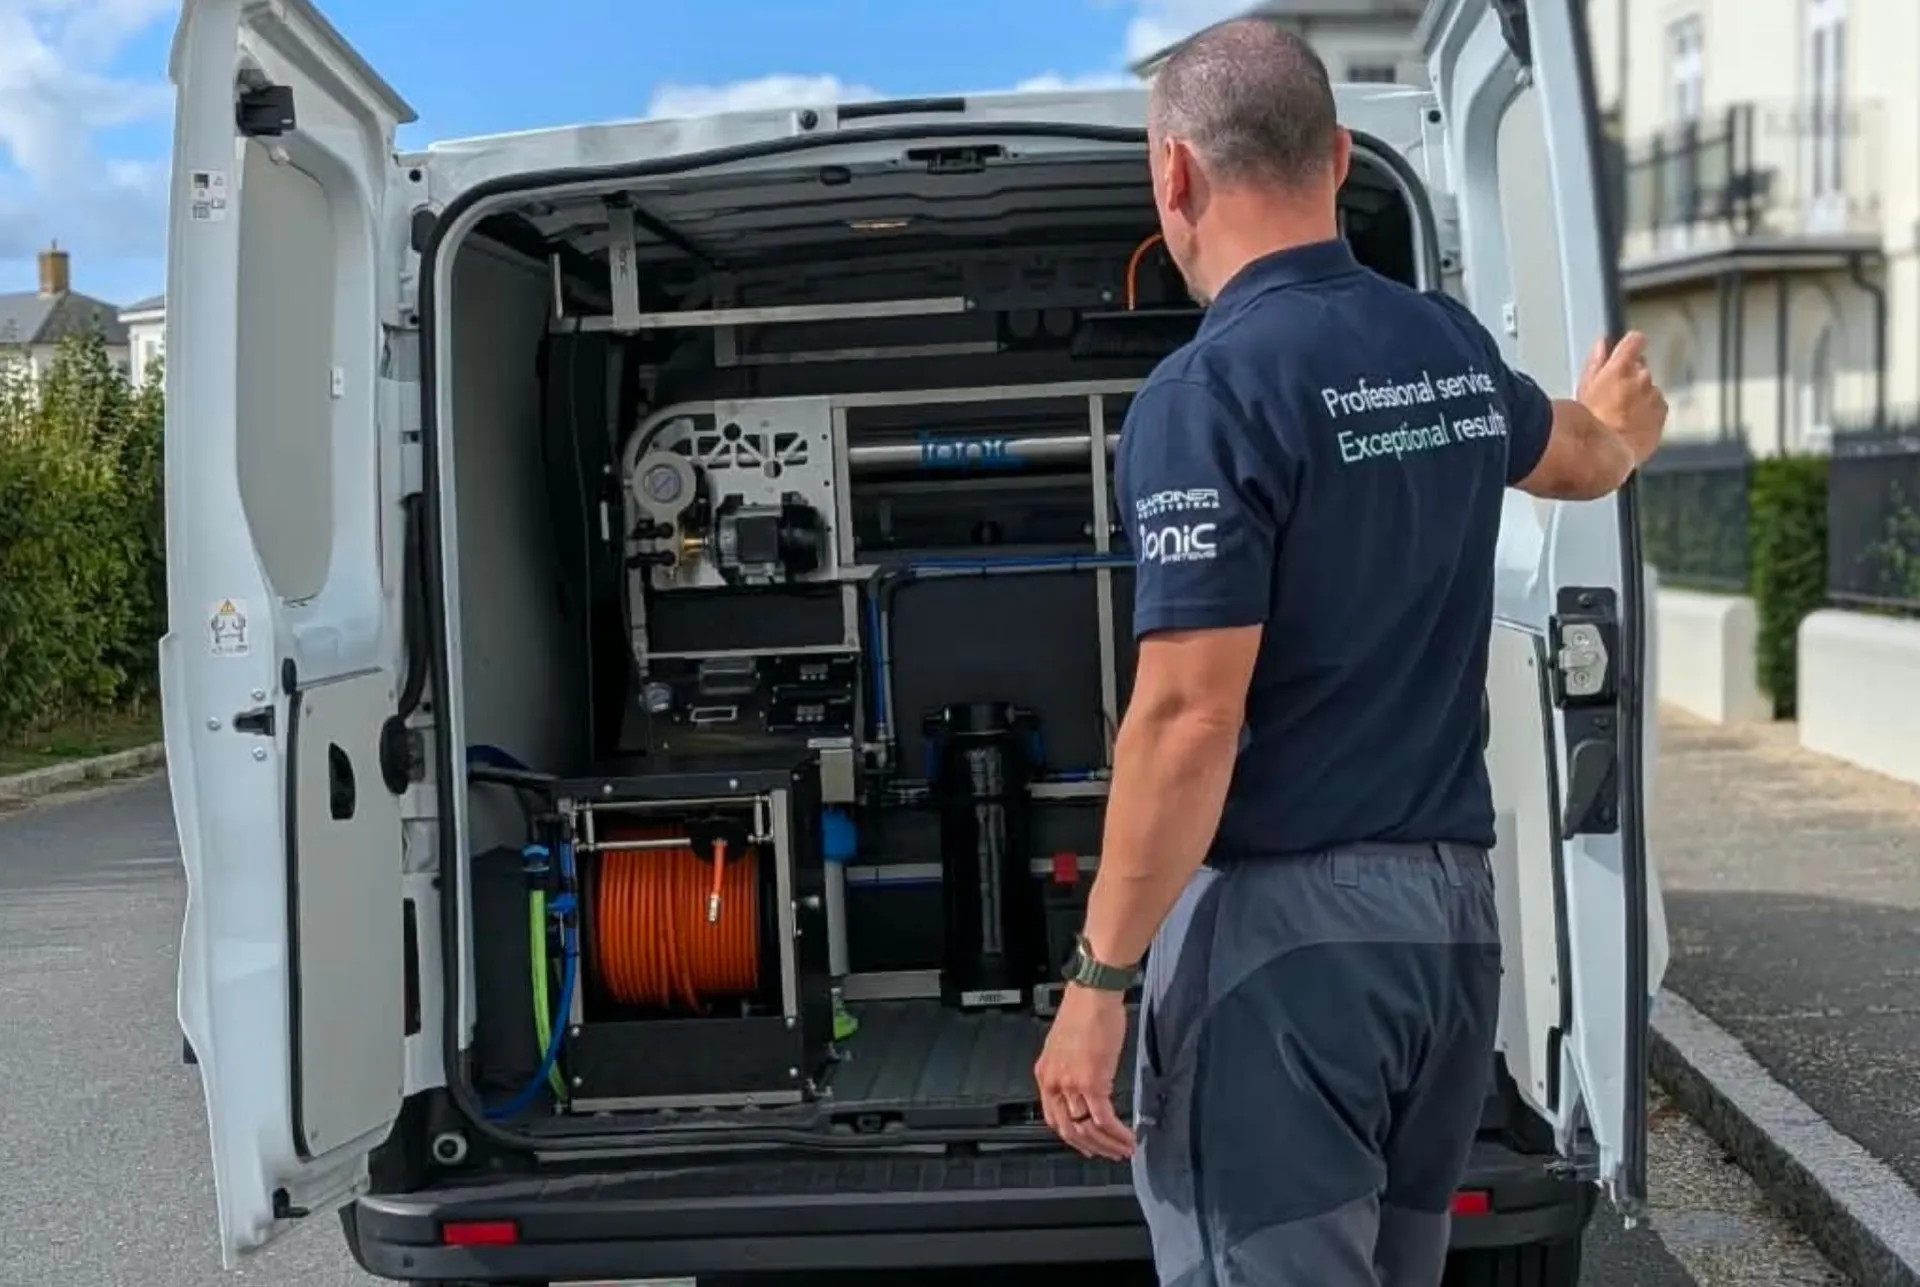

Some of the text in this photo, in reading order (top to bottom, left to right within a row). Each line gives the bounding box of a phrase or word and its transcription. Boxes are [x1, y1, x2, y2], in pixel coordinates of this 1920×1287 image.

[1321, 366, 1496, 418] Professional service
[1337, 412, 1451, 463] Exceptional
